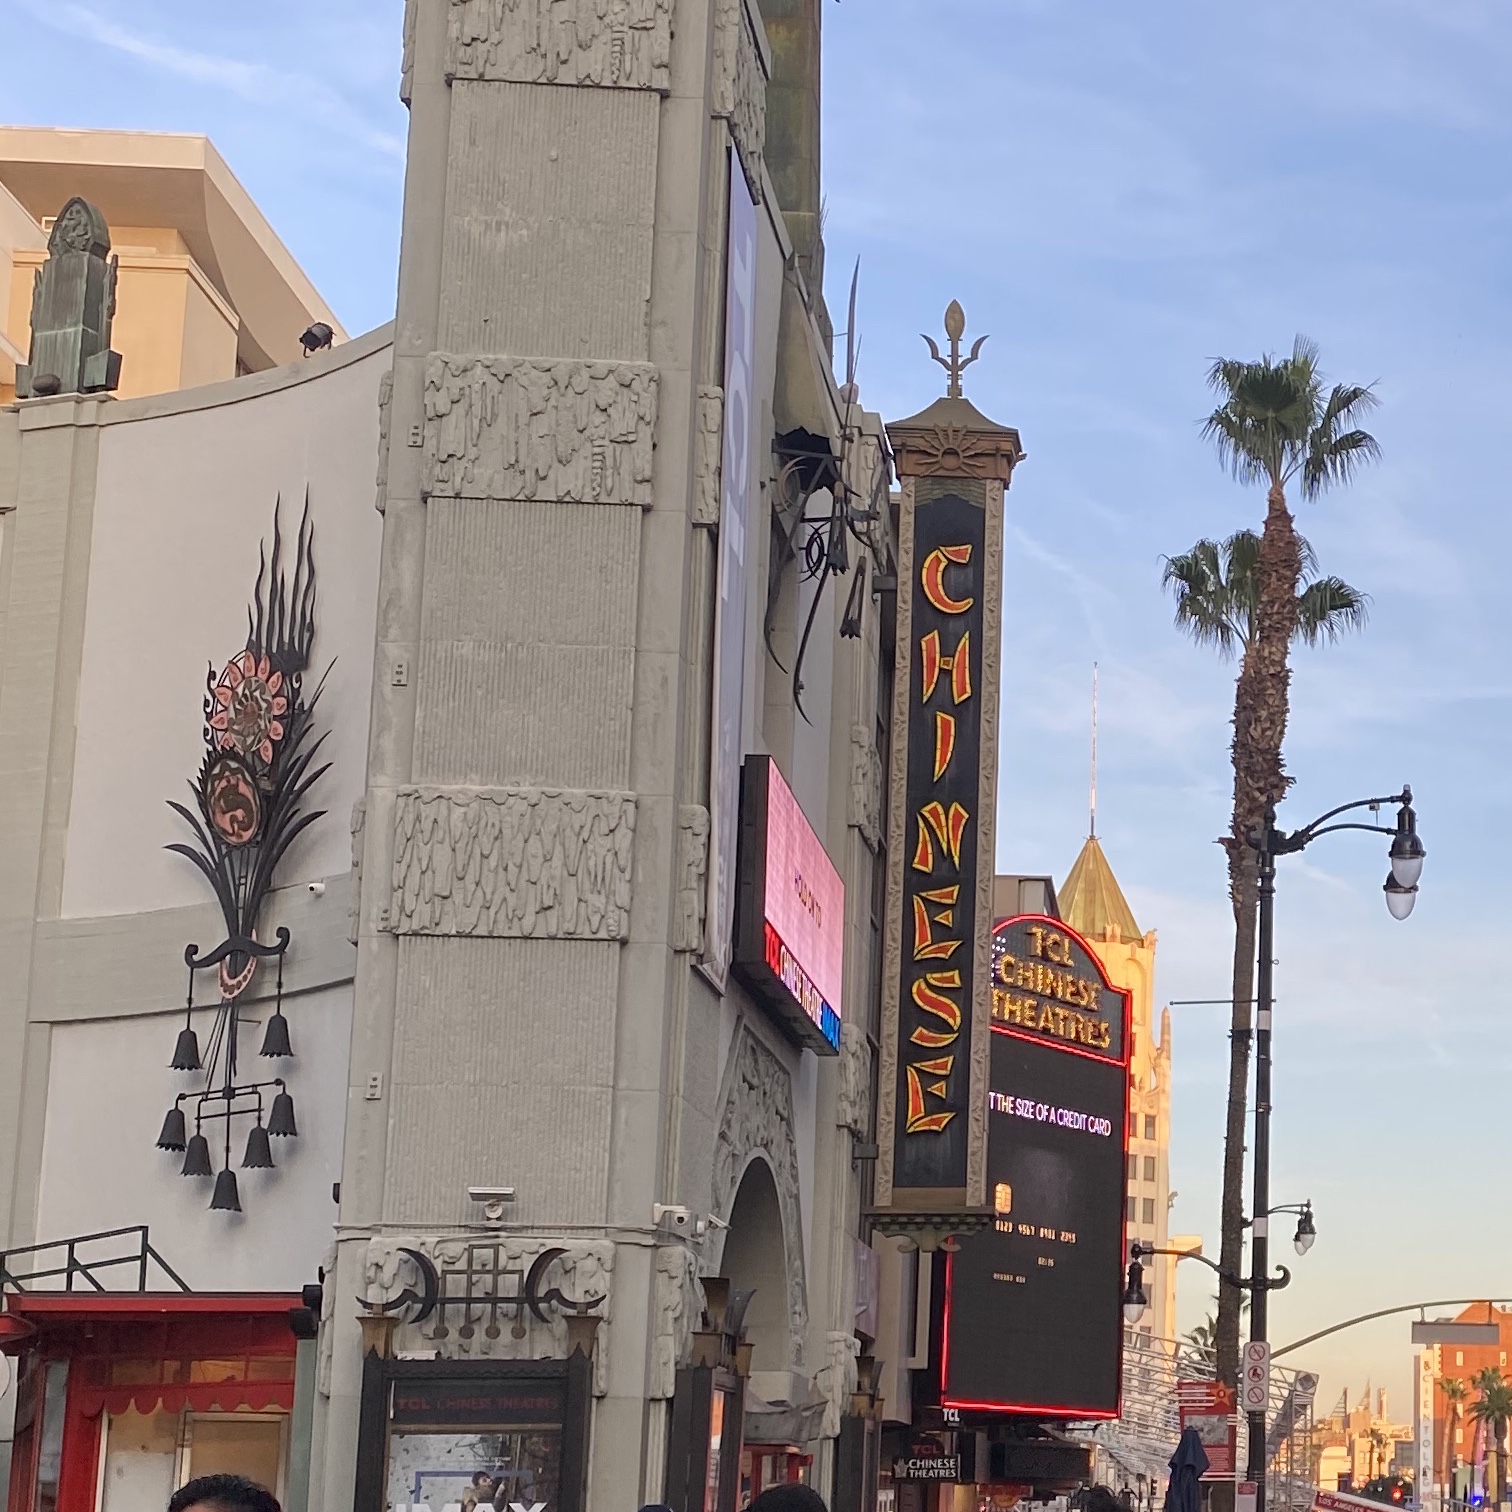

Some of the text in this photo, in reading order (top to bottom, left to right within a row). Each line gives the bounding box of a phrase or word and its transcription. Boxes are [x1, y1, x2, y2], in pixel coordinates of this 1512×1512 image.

[907, 544, 974, 1134] CHINESE
[1024, 924, 1075, 967] TCL
[999, 954, 1102, 1012] CHINESE
[991, 987, 1112, 1050] THEATRES
[997, 1093, 1015, 1115] THE
[1015, 1098, 1035, 1119] SIZE
[1036, 1103, 1050, 1123] OF
[1048, 1107, 1057, 1124] A
[1057, 1108, 1088, 1131] CREDIT
[1088, 1115, 1112, 1137] CARD
[942, 1408, 960, 1422] TCL
[908, 1458, 956, 1468] CHINESE
[912, 1444, 937, 1454] TCL
[909, 1469, 957, 1478] THEATRES
[1318, 1496, 1333, 1507] LOS
